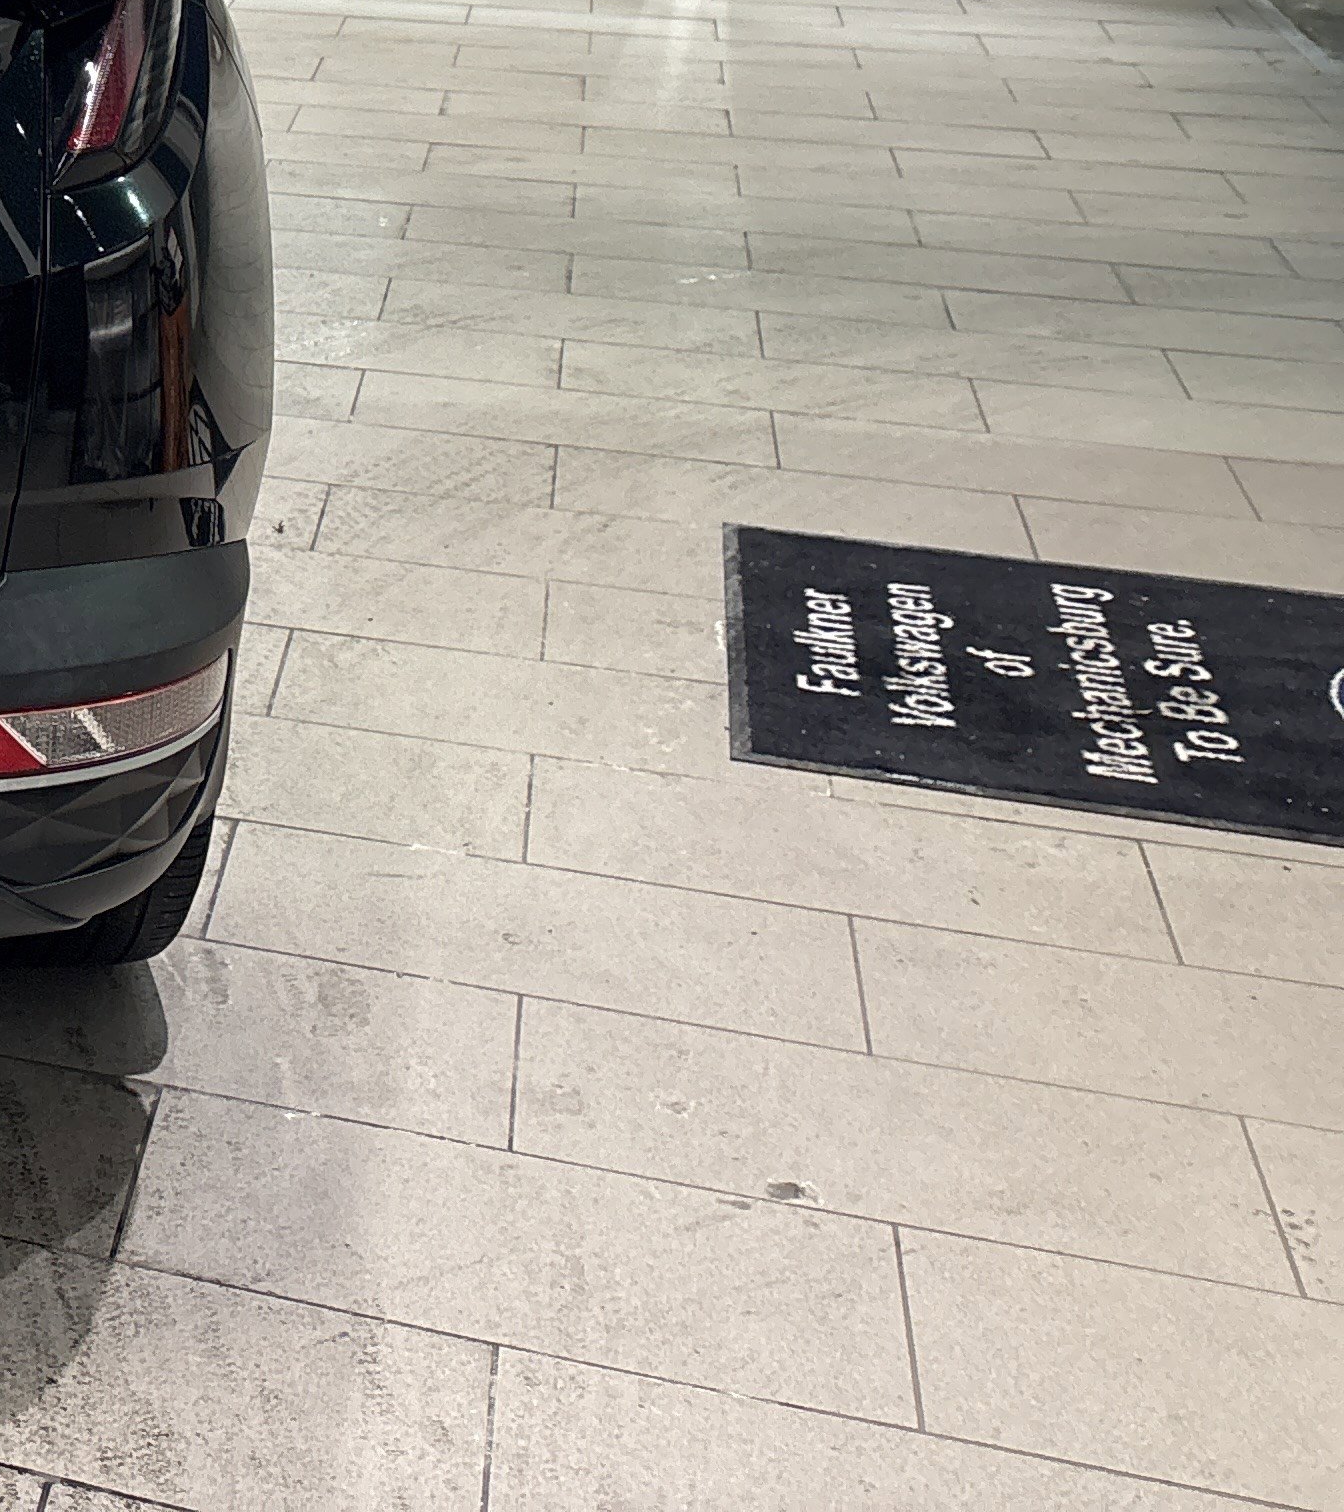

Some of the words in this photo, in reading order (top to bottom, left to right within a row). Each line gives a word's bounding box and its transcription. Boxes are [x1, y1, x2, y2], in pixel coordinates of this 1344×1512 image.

[793, 587, 862, 697] Faulkner
[881, 582, 958, 728] Volkswagen
[965, 645, 1034, 679] of
[1143, 619, 1213, 681] Sure.
[1046, 582, 1159, 785] Mechanicsburg
[1156, 686, 1229, 724] Be
[1173, 730, 1245, 763] To
